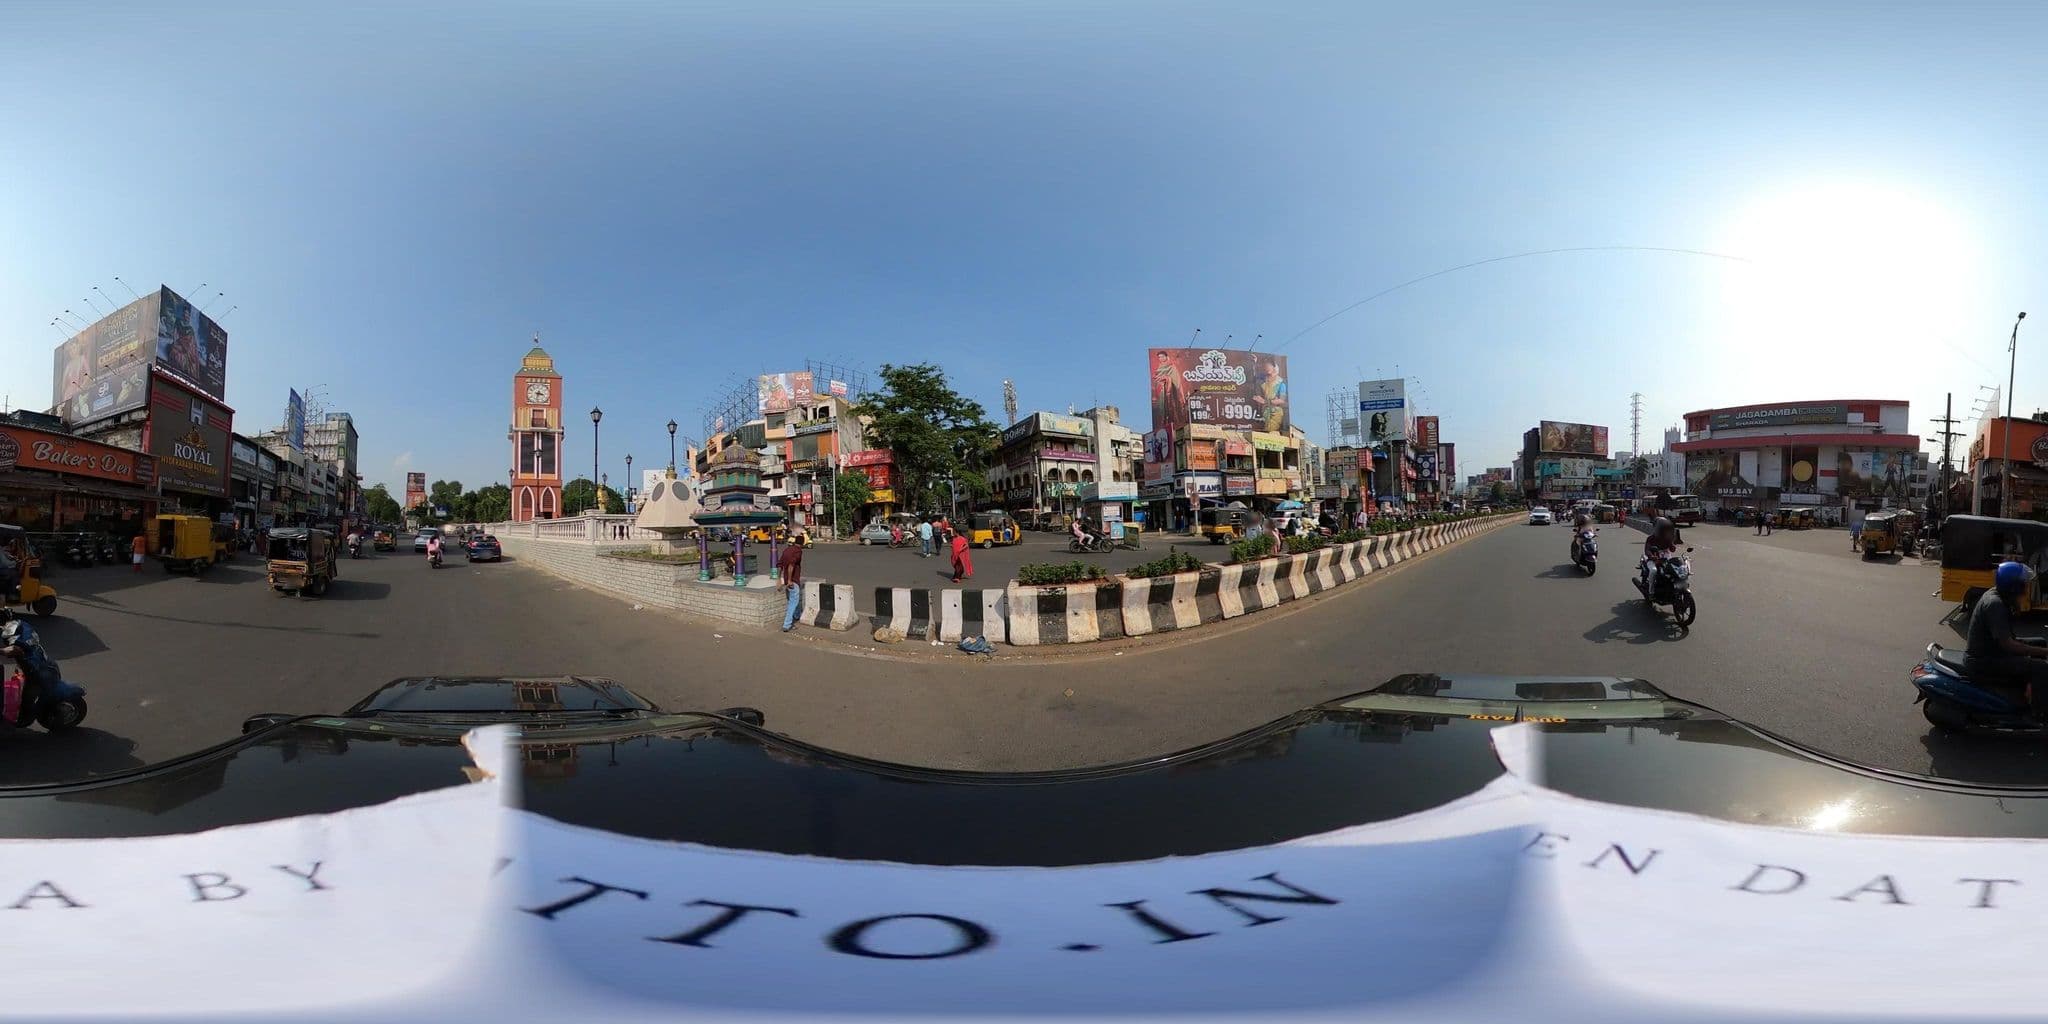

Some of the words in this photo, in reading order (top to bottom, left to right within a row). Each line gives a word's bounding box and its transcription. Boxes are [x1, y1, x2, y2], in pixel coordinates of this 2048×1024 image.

[1225, 405, 1261, 420] 999/-
[1735, 407, 1798, 420] JAGADAMBA
[32, 440, 97, 469] Baker's
[100, 454, 131, 476] Den
[174, 443, 212, 466] ROYAL
[1198, 484, 1222, 492] JEANS
[184, 860, 333, 903] BY
